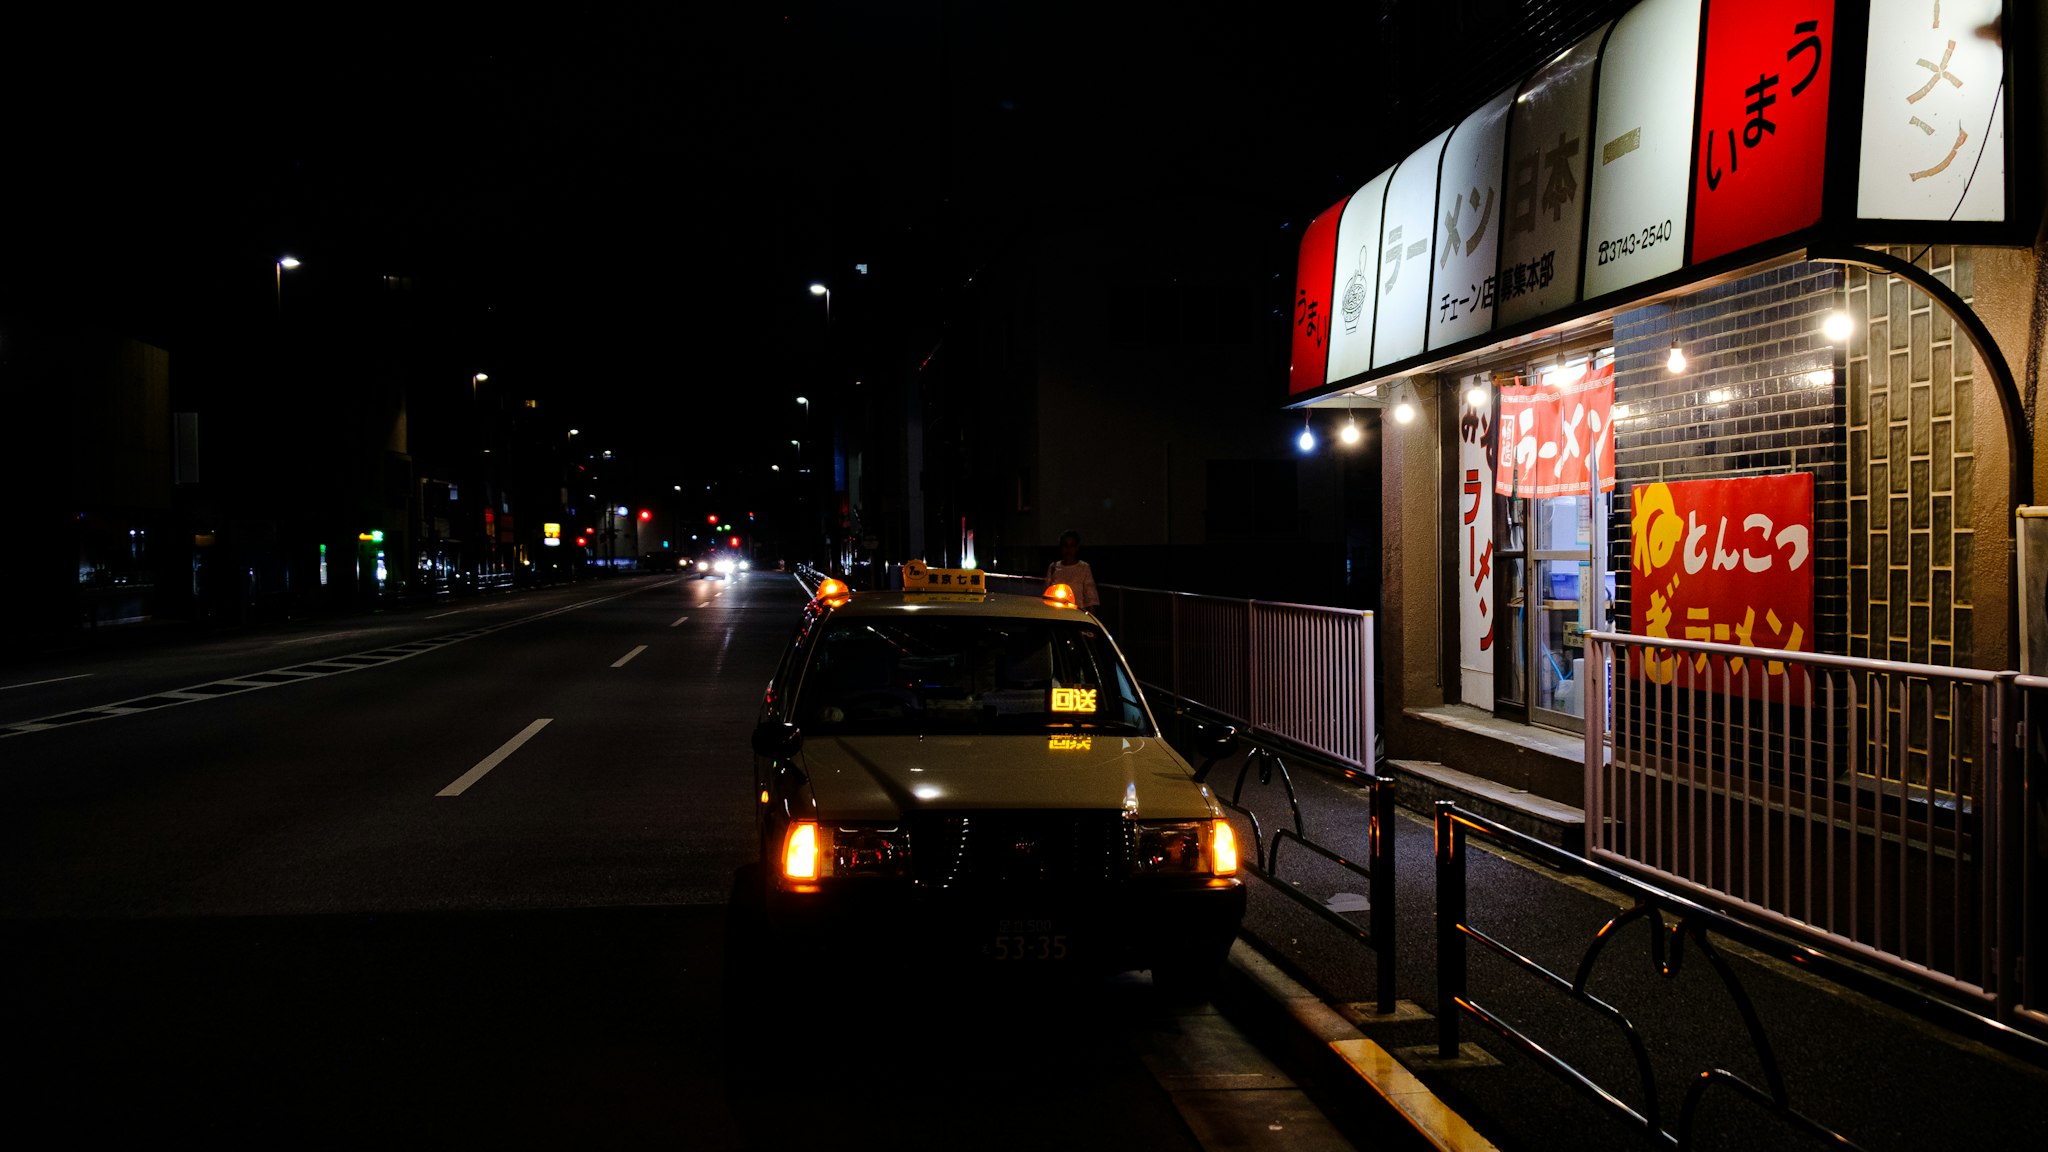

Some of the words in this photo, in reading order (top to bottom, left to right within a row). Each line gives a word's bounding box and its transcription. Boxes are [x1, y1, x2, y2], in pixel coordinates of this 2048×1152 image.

[1706, 20, 1823, 192] うまい
[1297, 289, 1328, 348] うまい
[1683, 510, 1810, 575] とんこつ
[1631, 482, 1685, 685] ねぎ
[1685, 605, 1805, 676] ラーメン
[1051, 687, 1097, 712] 回送
[994, 935, 1067, 961] 53-35
